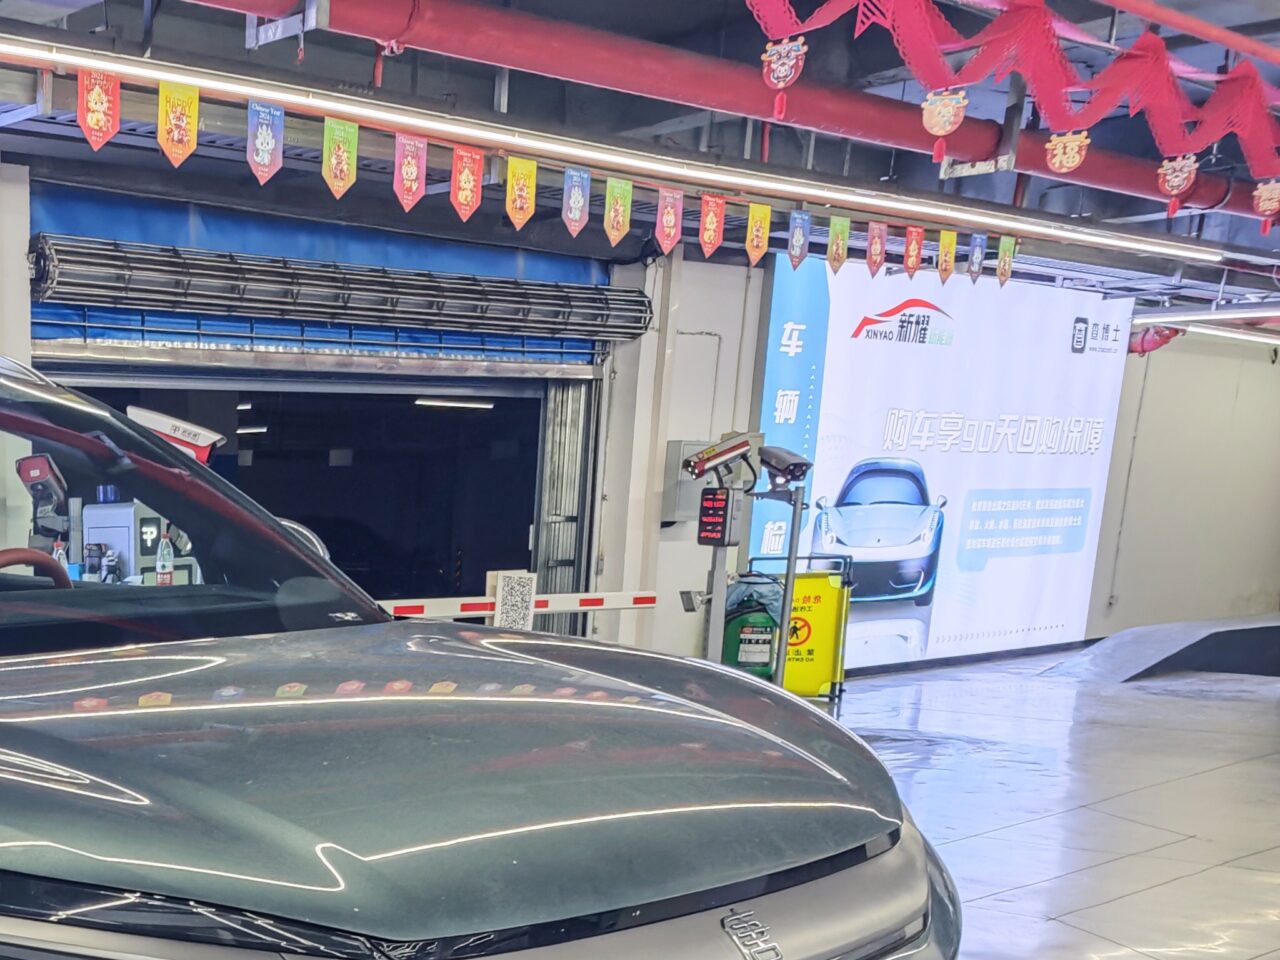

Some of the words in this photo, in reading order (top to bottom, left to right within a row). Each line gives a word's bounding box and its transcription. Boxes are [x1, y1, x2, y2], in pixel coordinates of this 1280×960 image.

[865, 328, 894, 341] XINYAO
[883, 408, 1105, 455] 购车享90天回购保障
